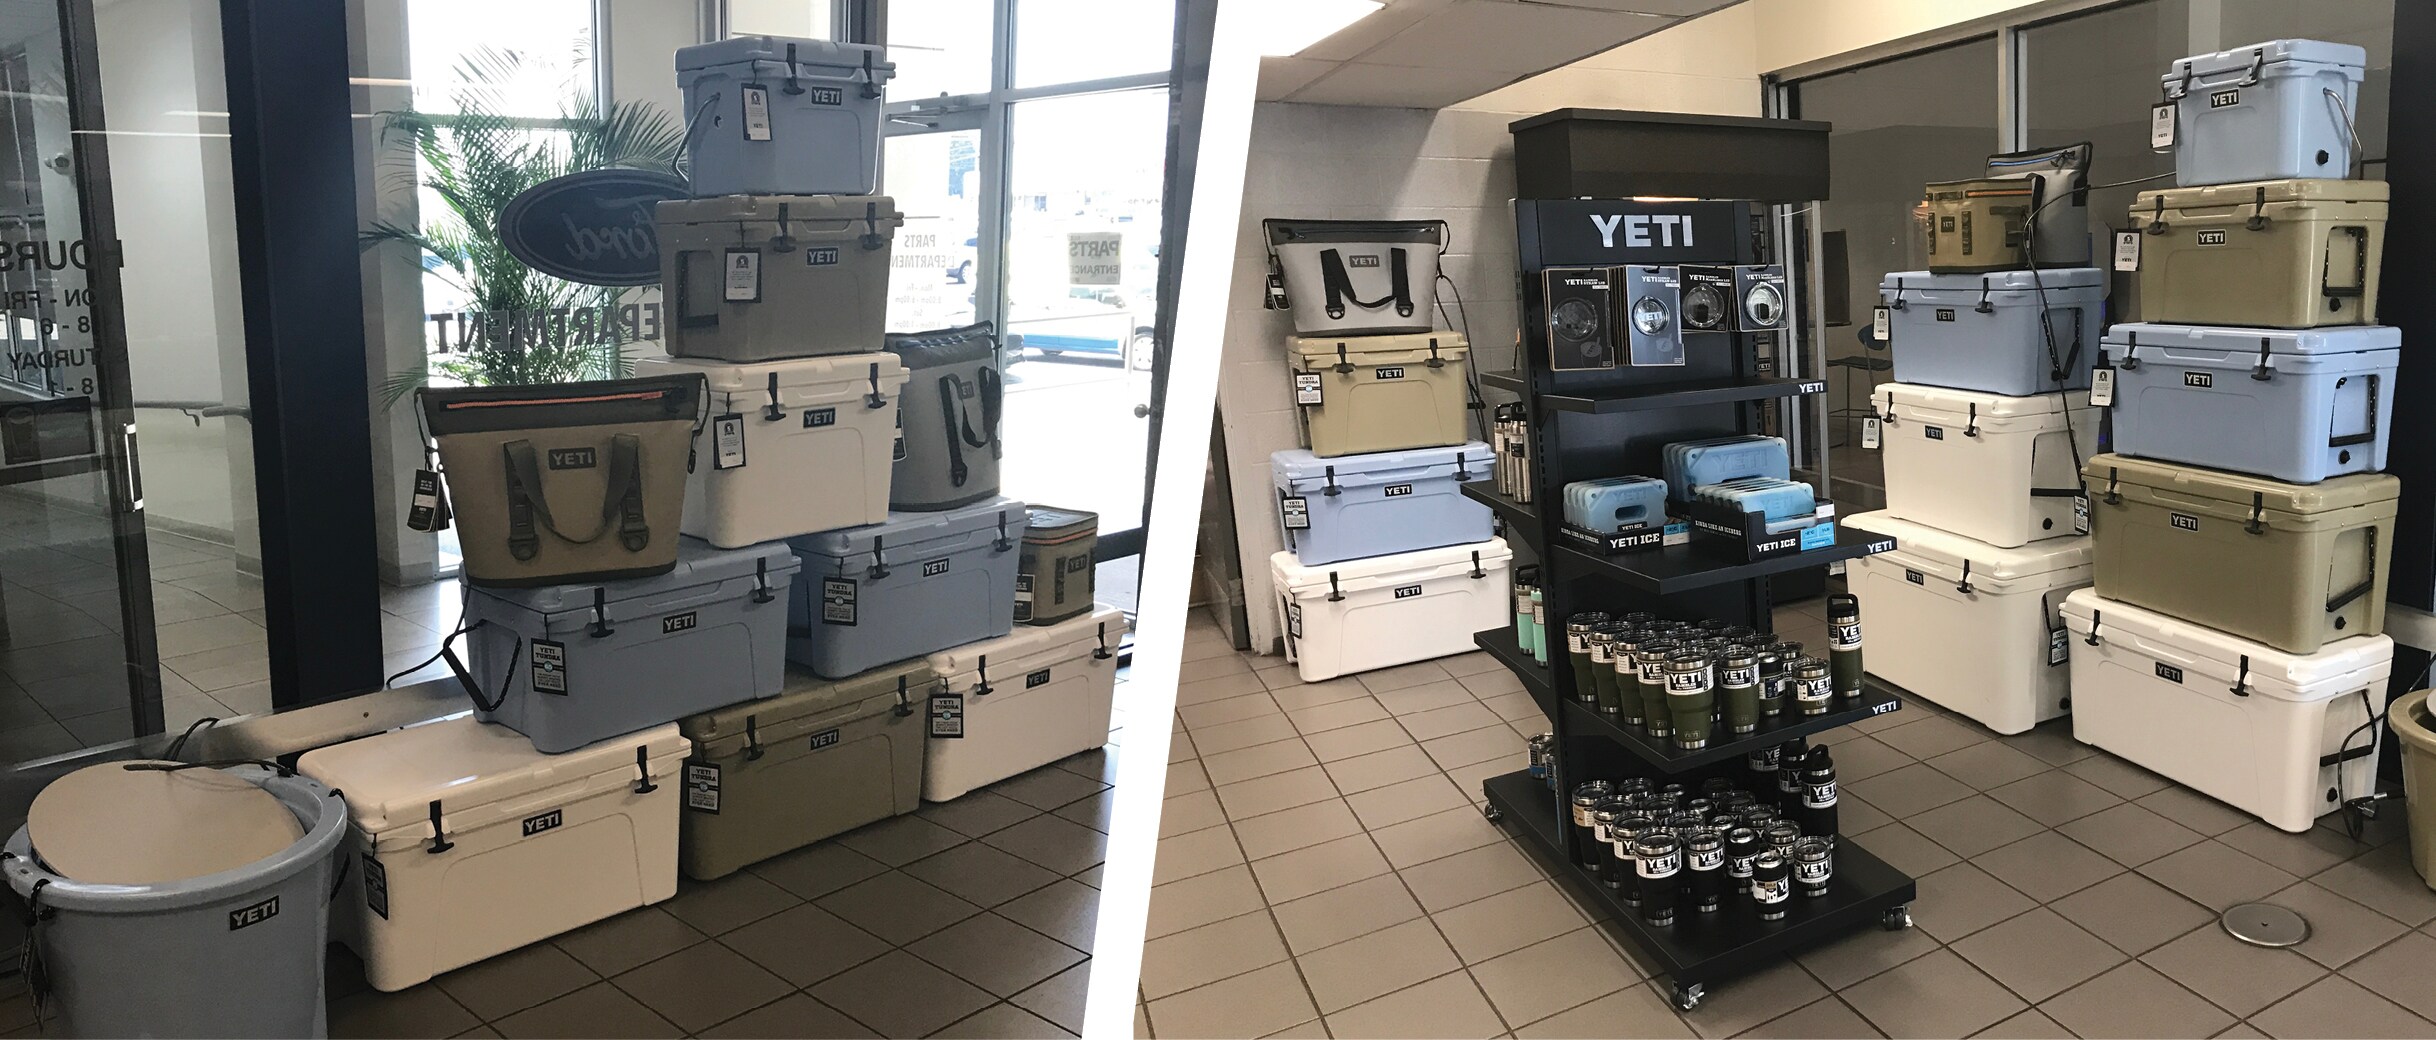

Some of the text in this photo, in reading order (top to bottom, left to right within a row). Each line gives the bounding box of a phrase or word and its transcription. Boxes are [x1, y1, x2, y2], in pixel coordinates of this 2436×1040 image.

[813, 90, 840, 104] YETI
[2212, 92, 2238, 106] YETI
[1589, 214, 1694, 248] YETI
[2199, 233, 2224, 243] YETI
[809, 250, 837, 264] YETI
[1351, 256, 1378, 266] YETI
[1937, 311, 1954, 320] YETI
[1378, 369, 1403, 378] YETI
[2186, 374, 2211, 386] YETI
[1798, 382, 1824, 394] YETI
[806, 411, 833, 425] YETI
[1926, 428, 1942, 438] YETI
[552, 452, 592, 466] YETI
[1713, 452, 1768, 474] YETI
[1386, 486, 1410, 496] YETI
[2172, 515, 2197, 530] YETI
[1610, 533, 1660, 548] YETI ICE
[1757, 542, 1778, 552] YETI
[1780, 538, 1796, 548] ICE
[1868, 540, 1892, 553] YETI
[924, 560, 948, 575] YETI
[1070, 554, 1087, 568] YETI
[1907, 572, 1923, 584] YETI
[1396, 586, 1420, 597] YETI
[664, 616, 695, 632] YETI
[1644, 663, 1664, 673] YE
[1723, 669, 1750, 679] YETI
[2156, 664, 2181, 682] YETI
[1027, 671, 1049, 687] YETI
[1670, 672, 1702, 683] YETI
[1872, 700, 1897, 715] YETI
[811, 732, 838, 748] YETI
[1765, 748, 1780, 759] YE
[1813, 783, 1836, 796] YETI
[524, 813, 560, 832] YETI
[1700, 848, 1723, 862] YETI
[1777, 846, 1793, 855] YE
[1646, 854, 1676, 868] YETI
[1734, 854, 1758, 867] YET
[1802, 860, 1828, 873] YETI
[231, 900, 278, 928] YETI
